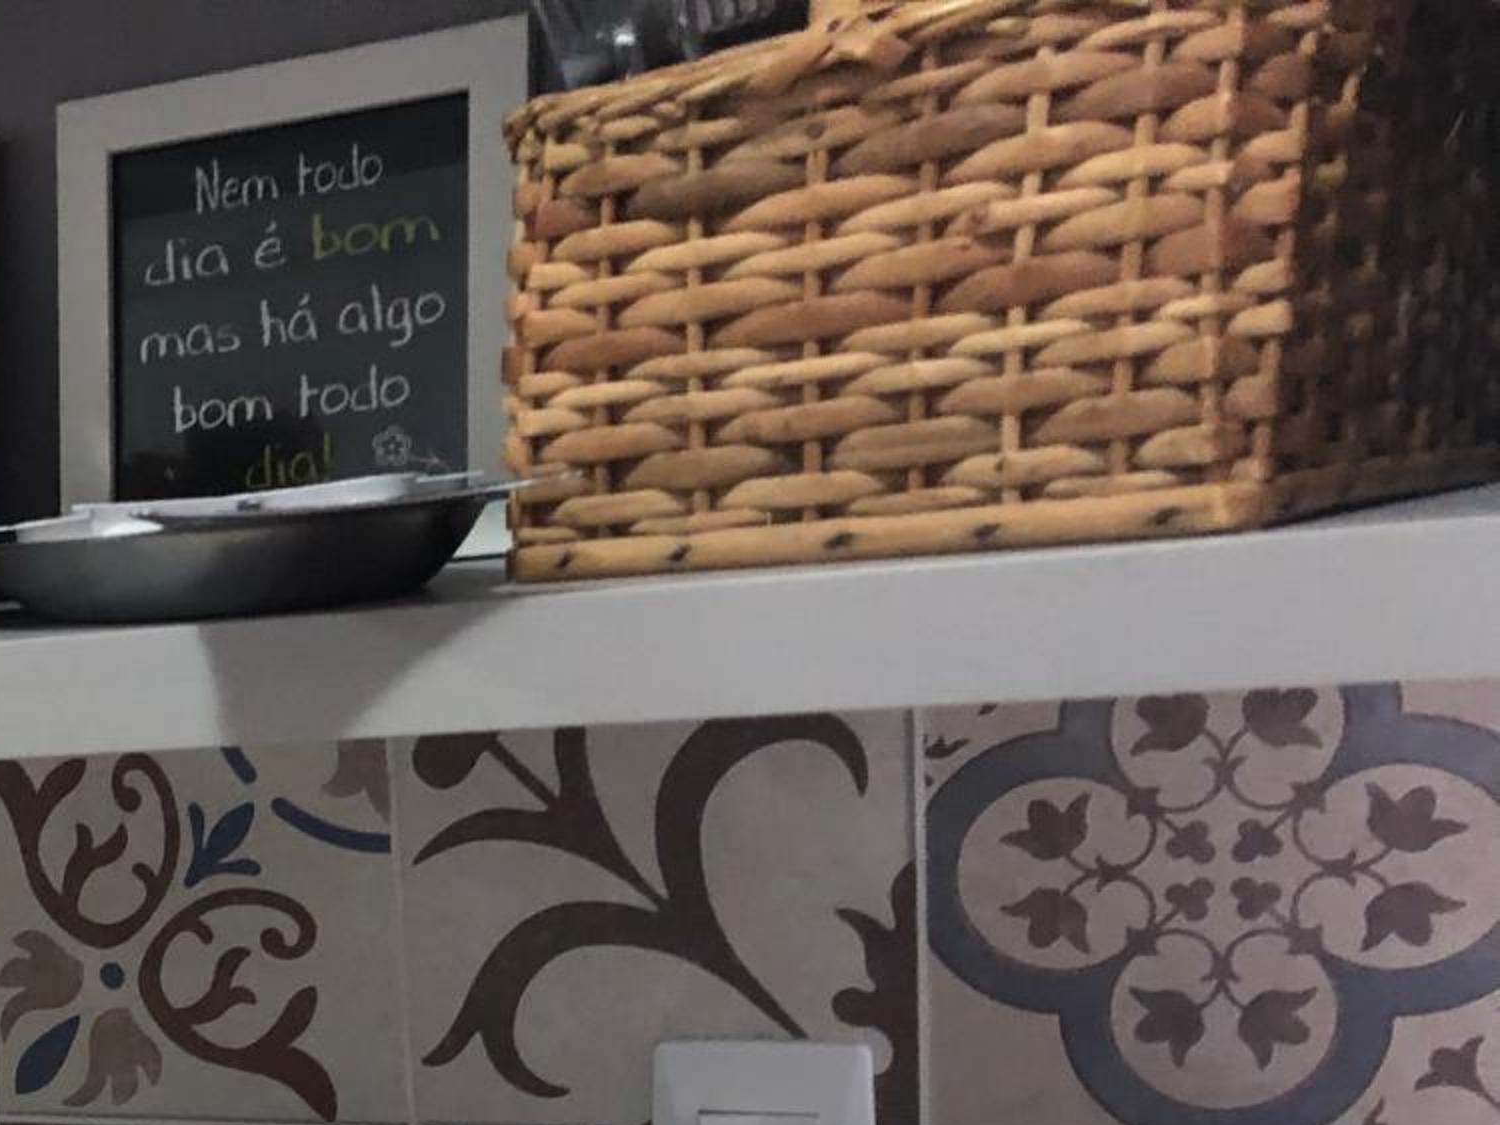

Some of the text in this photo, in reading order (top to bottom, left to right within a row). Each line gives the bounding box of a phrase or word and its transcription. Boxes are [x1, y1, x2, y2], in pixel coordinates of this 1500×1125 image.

[195, 143, 384, 214] Nem todo
[144, 213, 441, 286] dia é bom
[140, 284, 447, 364] mas há algo
[173, 364, 411, 433] bom todo
[244, 432, 333, 489] dia!
